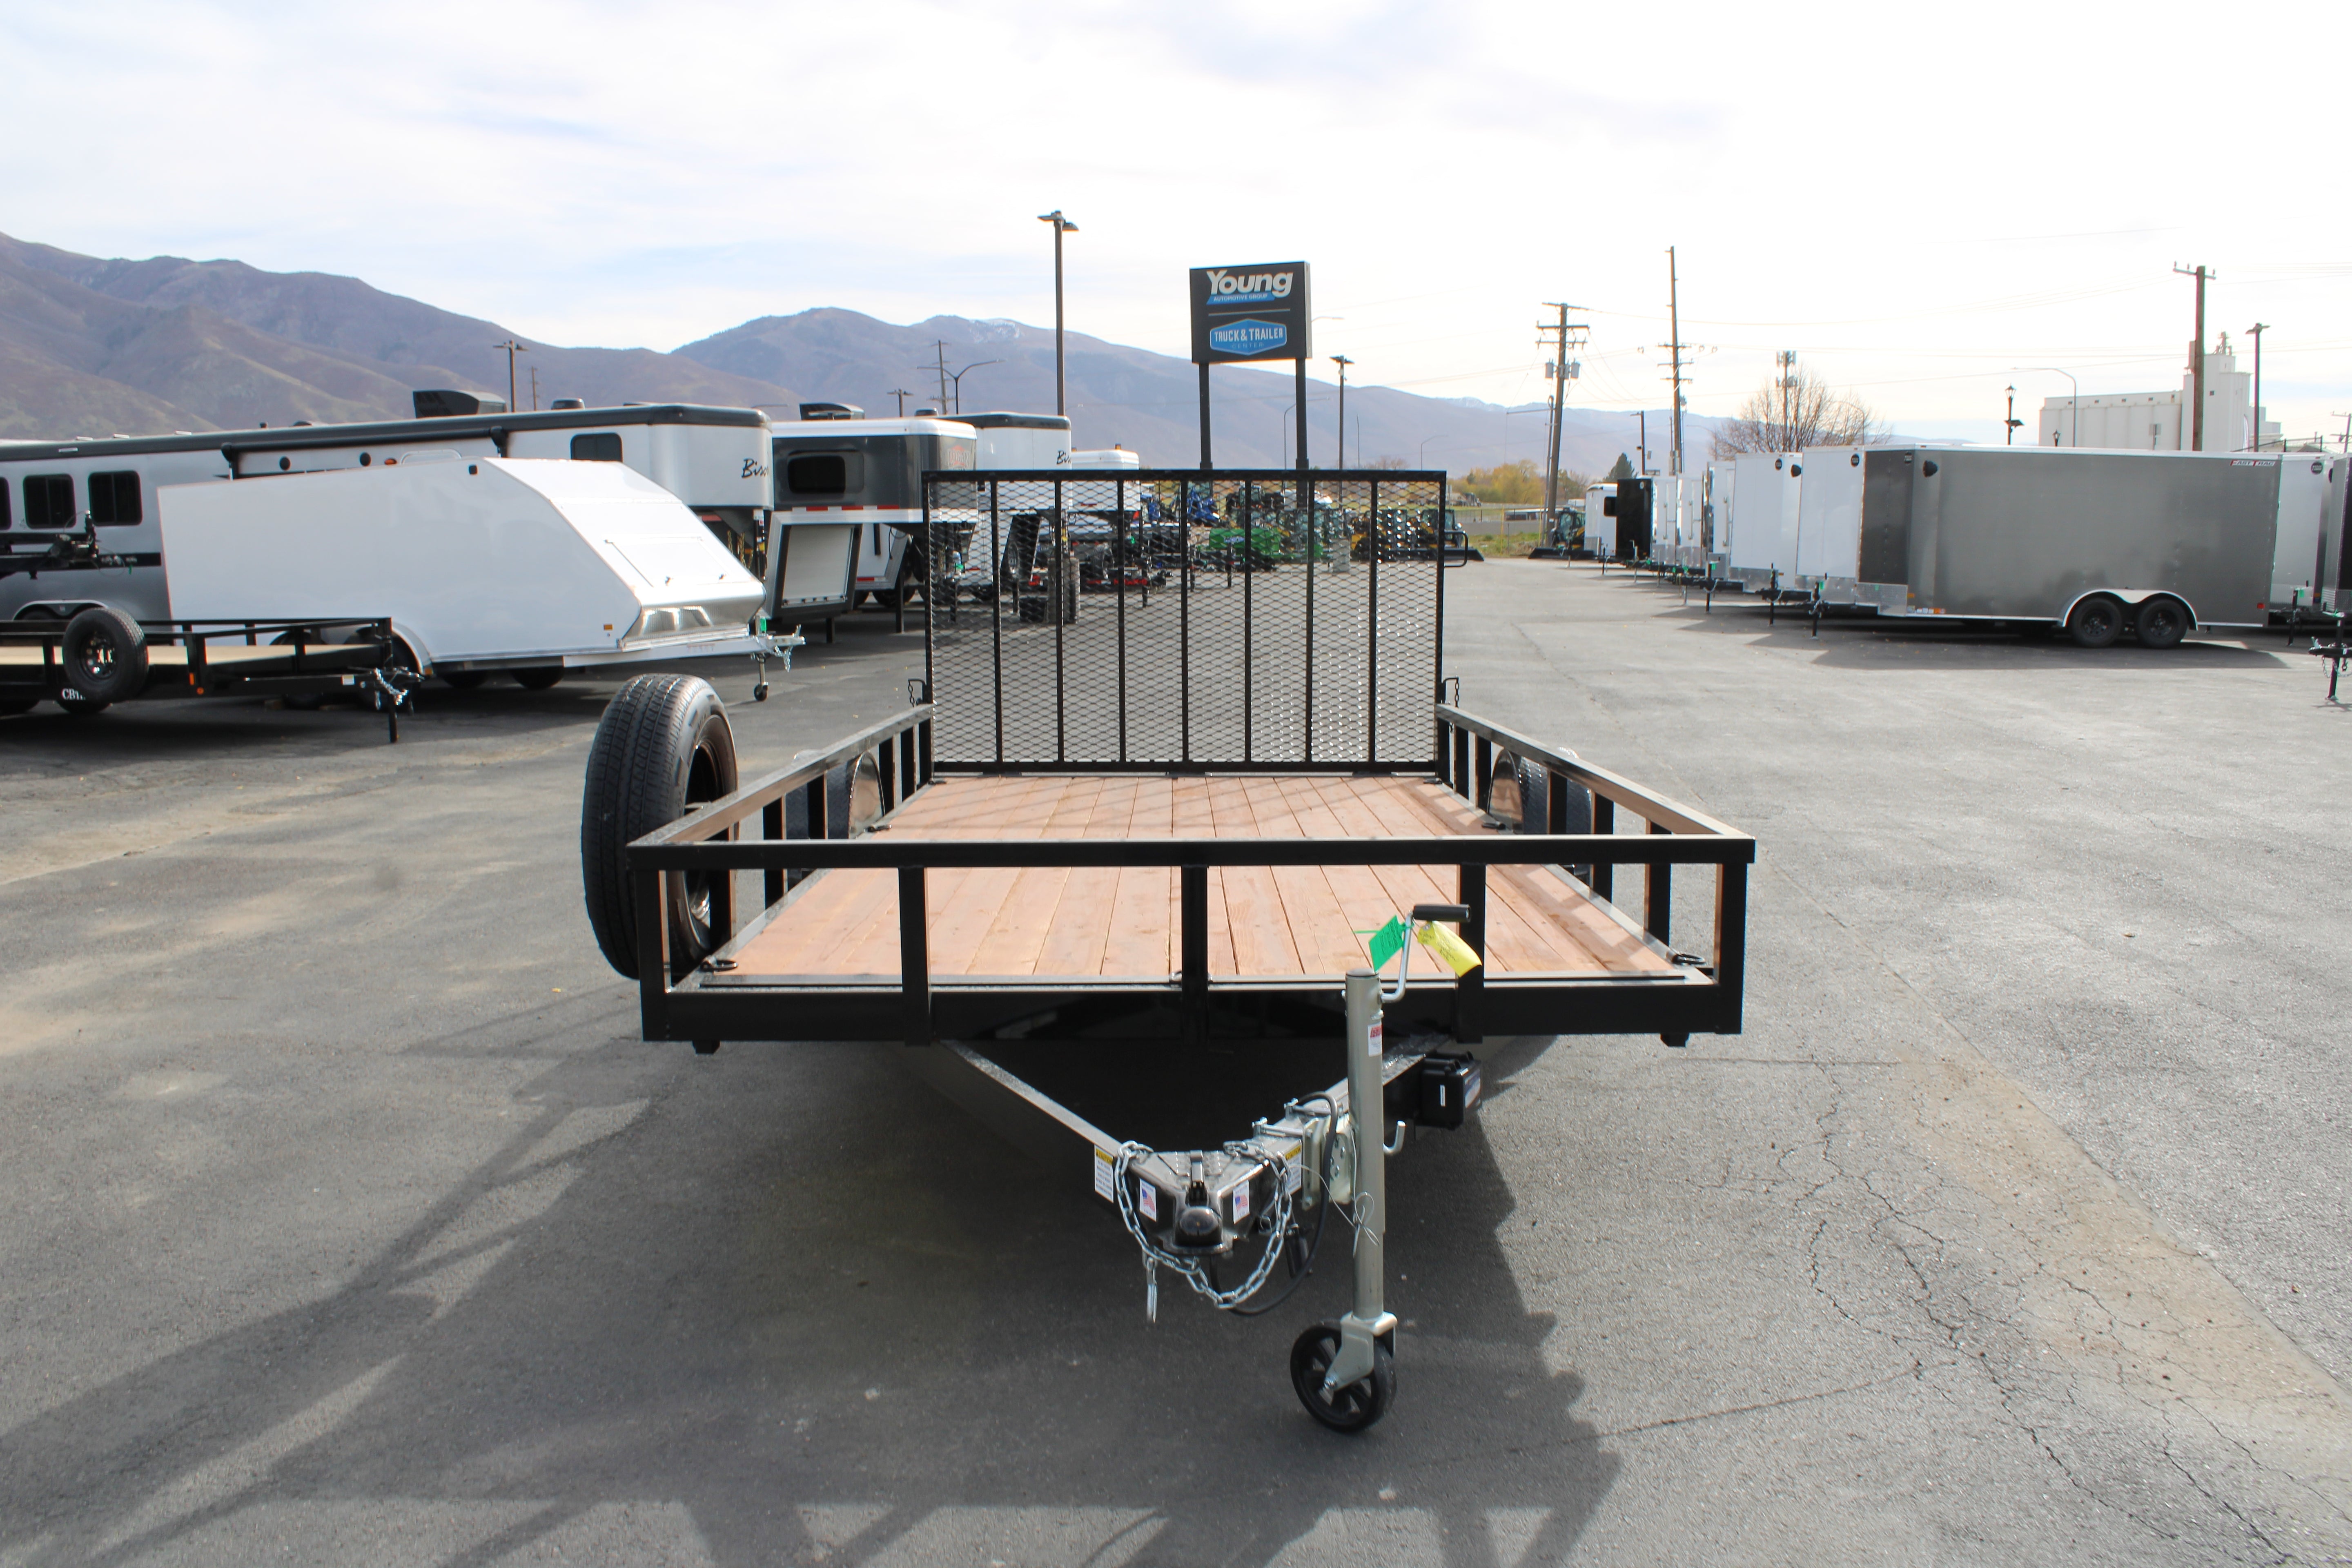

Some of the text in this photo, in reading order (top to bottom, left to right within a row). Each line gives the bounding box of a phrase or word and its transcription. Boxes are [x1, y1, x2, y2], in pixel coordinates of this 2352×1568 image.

[1206, 269, 1294, 298] Young
[1214, 327, 1283, 342] TRUCK & TRAILER
[947, 449, 970, 468] LOGAN
